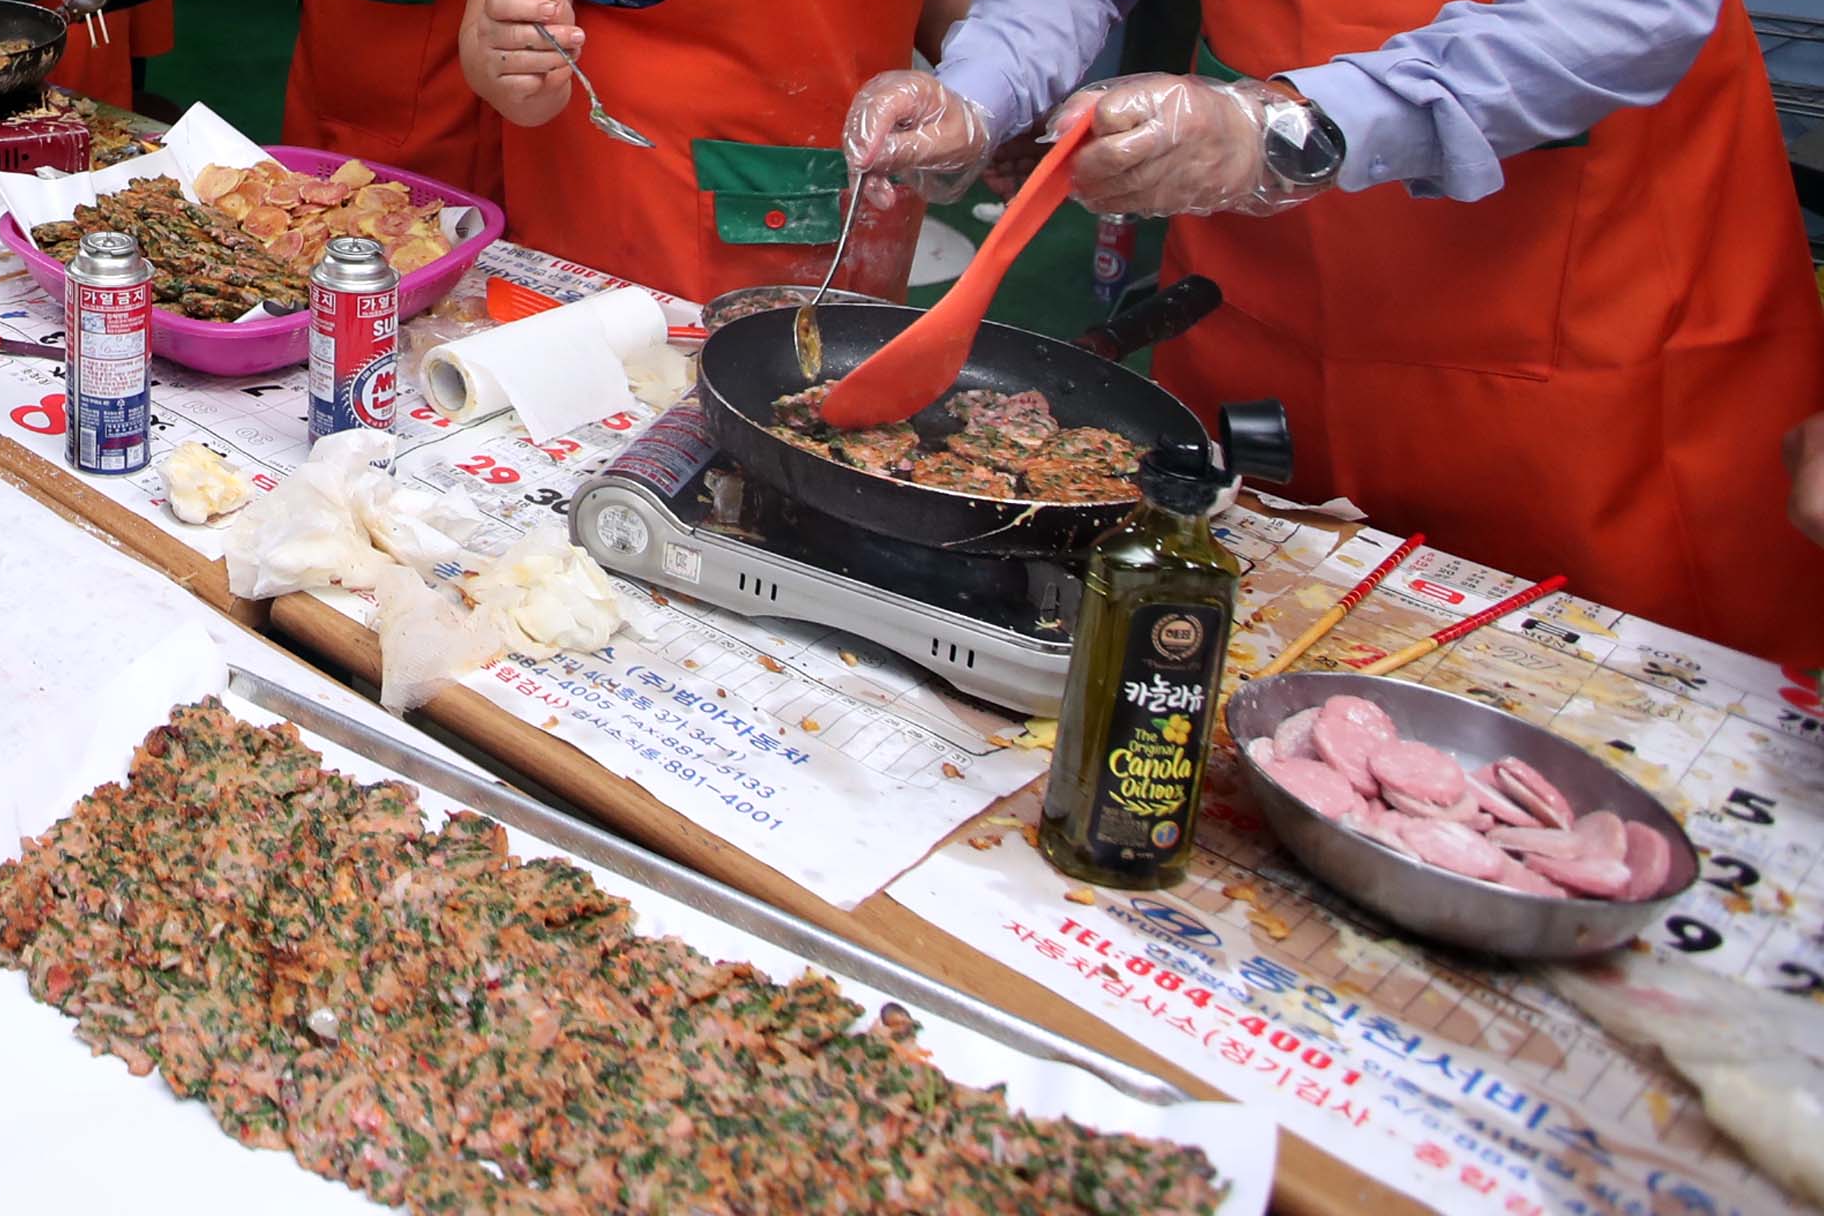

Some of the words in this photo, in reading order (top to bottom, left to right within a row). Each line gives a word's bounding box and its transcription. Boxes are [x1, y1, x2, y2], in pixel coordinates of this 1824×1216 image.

[83, 288, 144, 305] 가열금지
[454, 455, 521, 485] 29
[1124, 673, 1205, 714] 카놀라유
[507, 651, 616, 711] 884-4005
[621, 712, 777, 800] FAX:881-5133
[625, 664, 811, 767] (주)범아자동차
[689, 725, 749, 763] 34-1)
[1128, 739, 1177, 758] Original
[1134, 727, 1158, 743] The
[1108, 746, 1192, 780] Canola
[1057, 917, 1364, 1087] TEL:884-4001
